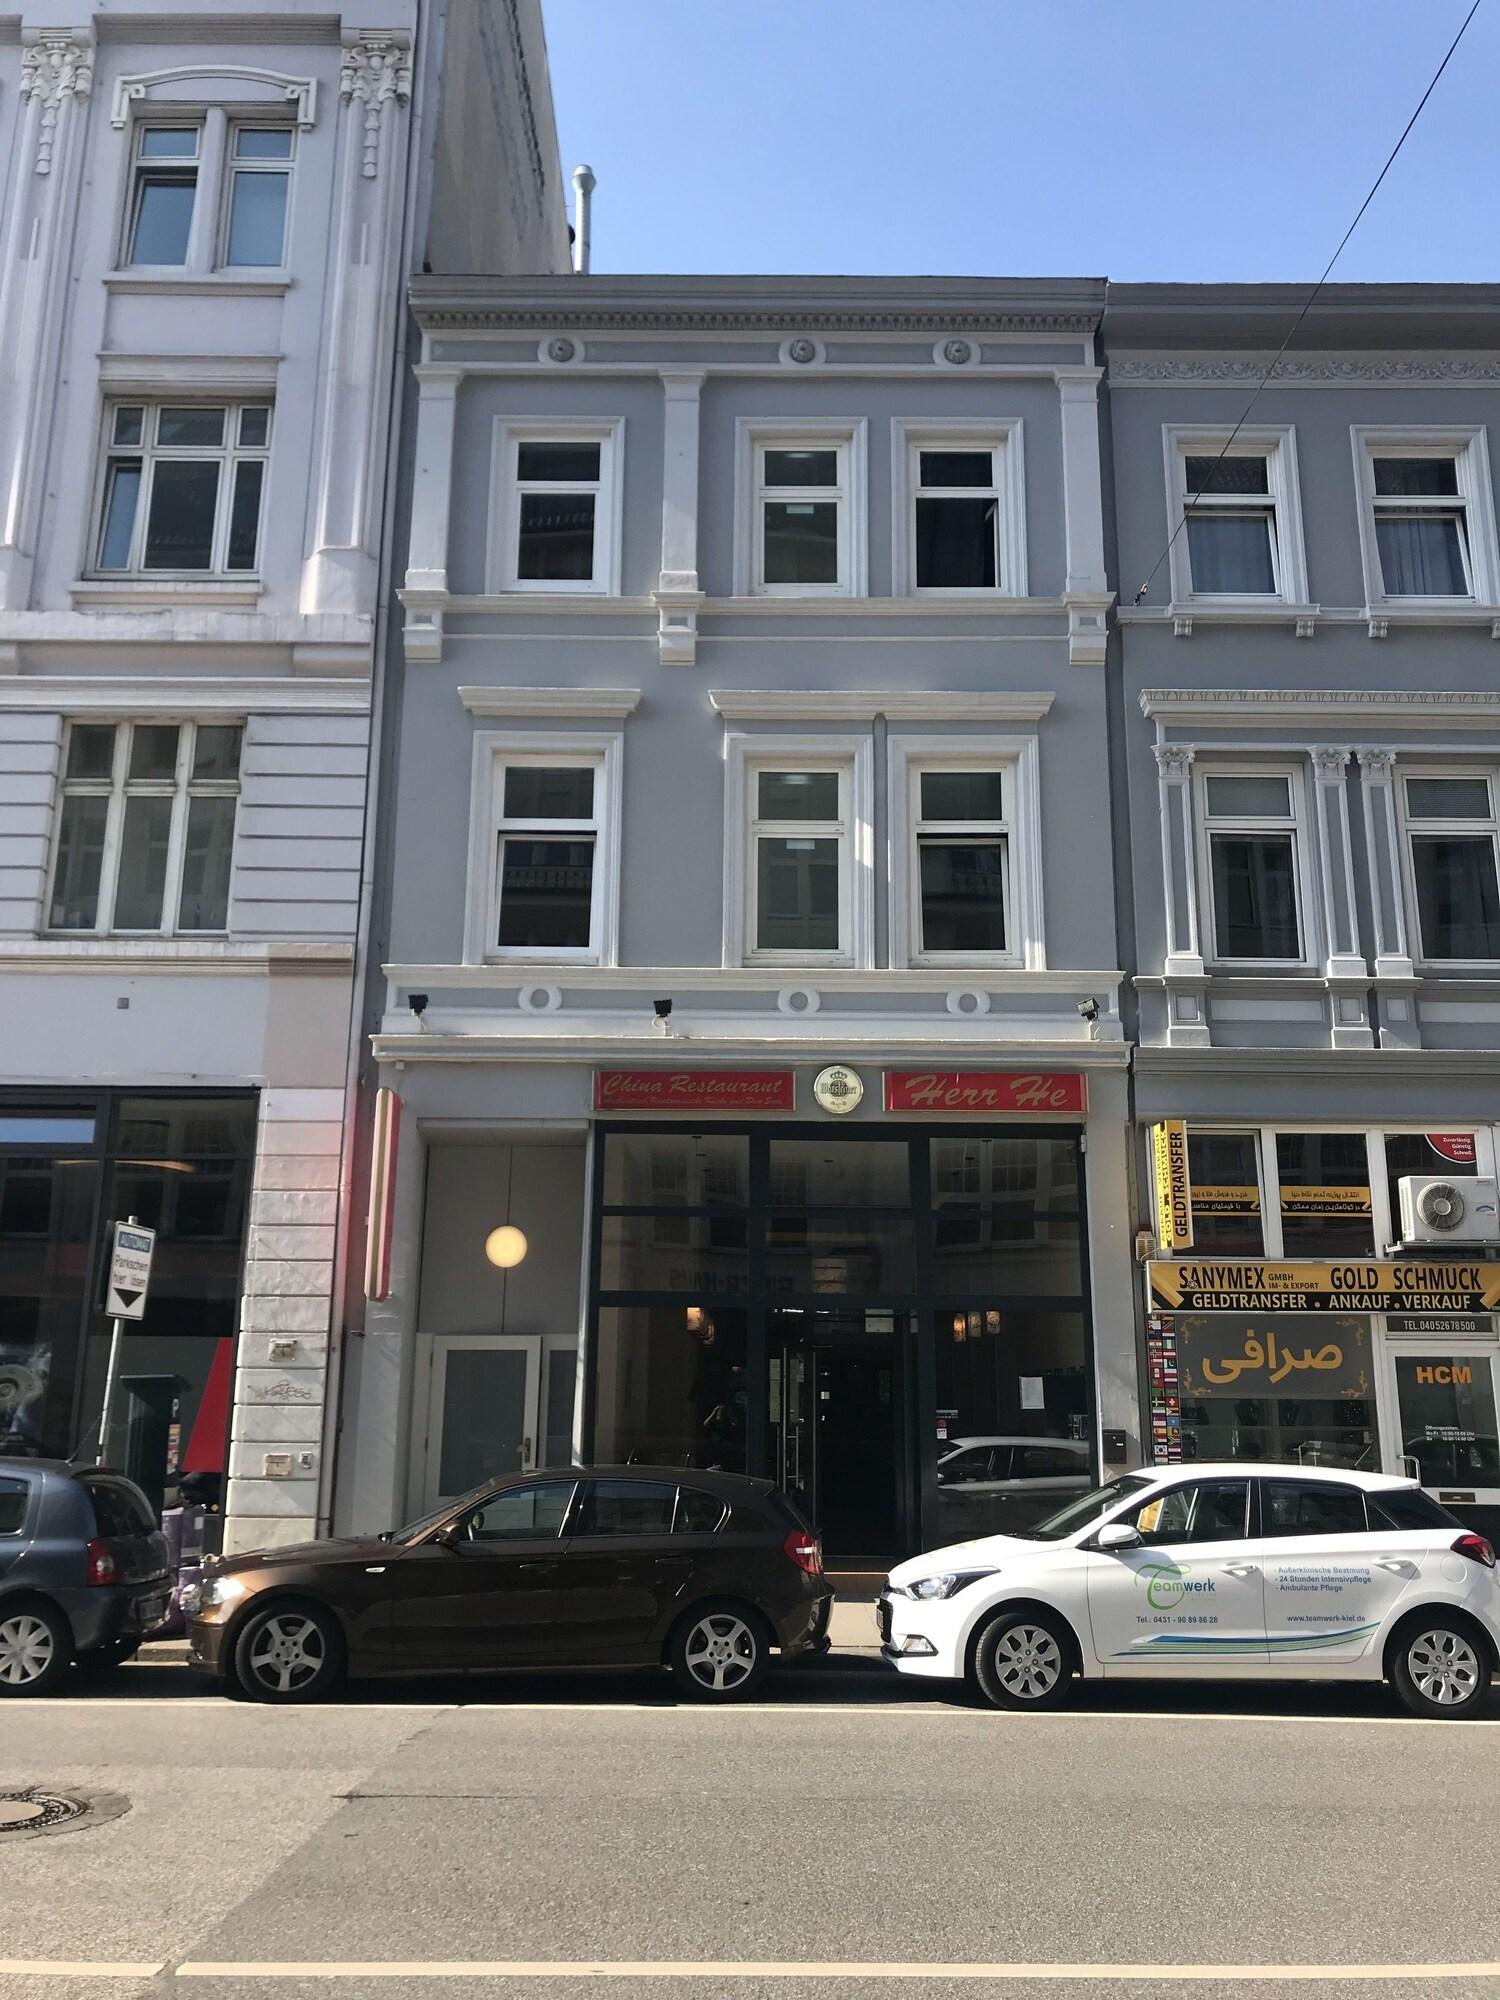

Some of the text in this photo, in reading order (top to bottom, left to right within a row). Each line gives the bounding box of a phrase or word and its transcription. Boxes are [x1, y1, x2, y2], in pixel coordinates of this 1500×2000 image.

[603, 1074, 782, 1095] China Restaurant
[905, 1075, 1067, 1107] Herr He
[1170, 1132, 1188, 1237] GELDTRANSFER
[1178, 1266, 1294, 1289] SANYMEX GMBH
[1330, 1267, 1482, 1290] GOLD SCHMUCK
[1192, 1294, 1471, 1309] GELDTRANSFER ANKAUF VERKAUF
[1403, 1320, 1476, 1331] TEL.04052678500
[1202, 1329, 1343, 1384] صرافی
[1416, 1366, 1472, 1384] HCM
[1321, 1576, 1372, 1584] Intensivpflege
[1333, 1567, 1370, 1575] Beatmung
[1320, 1584, 1343, 1592] Pflege
[1209, 1616, 1218, 1624] 28
